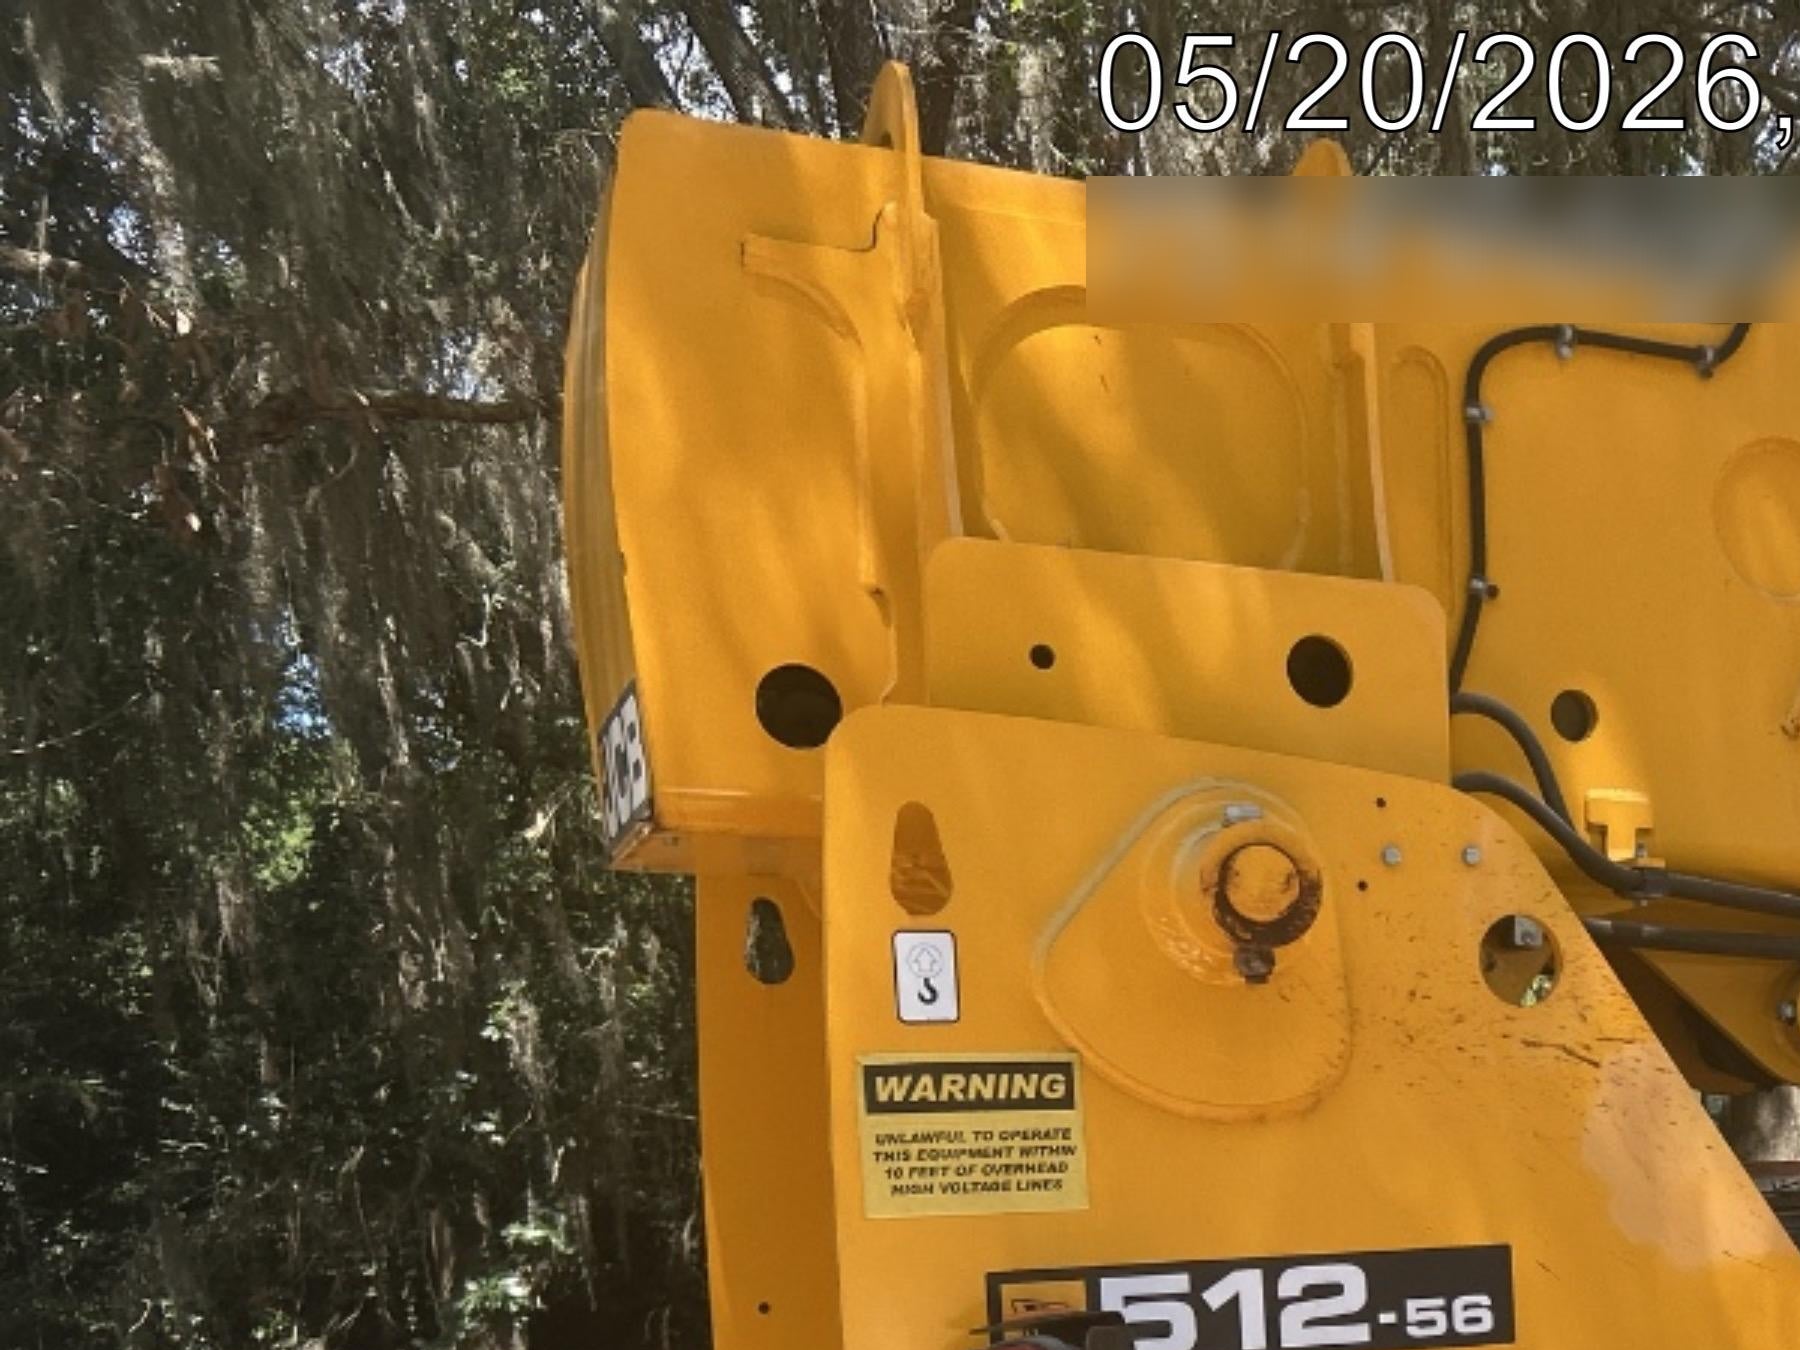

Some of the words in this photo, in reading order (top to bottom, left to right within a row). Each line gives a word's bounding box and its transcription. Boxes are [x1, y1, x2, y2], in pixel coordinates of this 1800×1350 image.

[874, 1072, 1067, 1103] WARNING
[874, 1130, 966, 1146] UNLAWFUL
[971, 1130, 994, 1142] TO
[998, 1127, 1072, 1142] OPERATE
[872, 1149, 911, 1163] THIS
[917, 1146, 1014, 1162] EQUIPMENT
[1018, 1145, 1078, 1159] WITHIN
[884, 1166, 904, 1179] 10
[908, 1166, 950, 1179] FEET
[955, 1163, 978, 1176] OF
[981, 1161, 1069, 1176] OVERHEAD
[939, 1180, 1012, 1195] VOLTAGE
[1016, 1179, 1063, 1193] LINES
